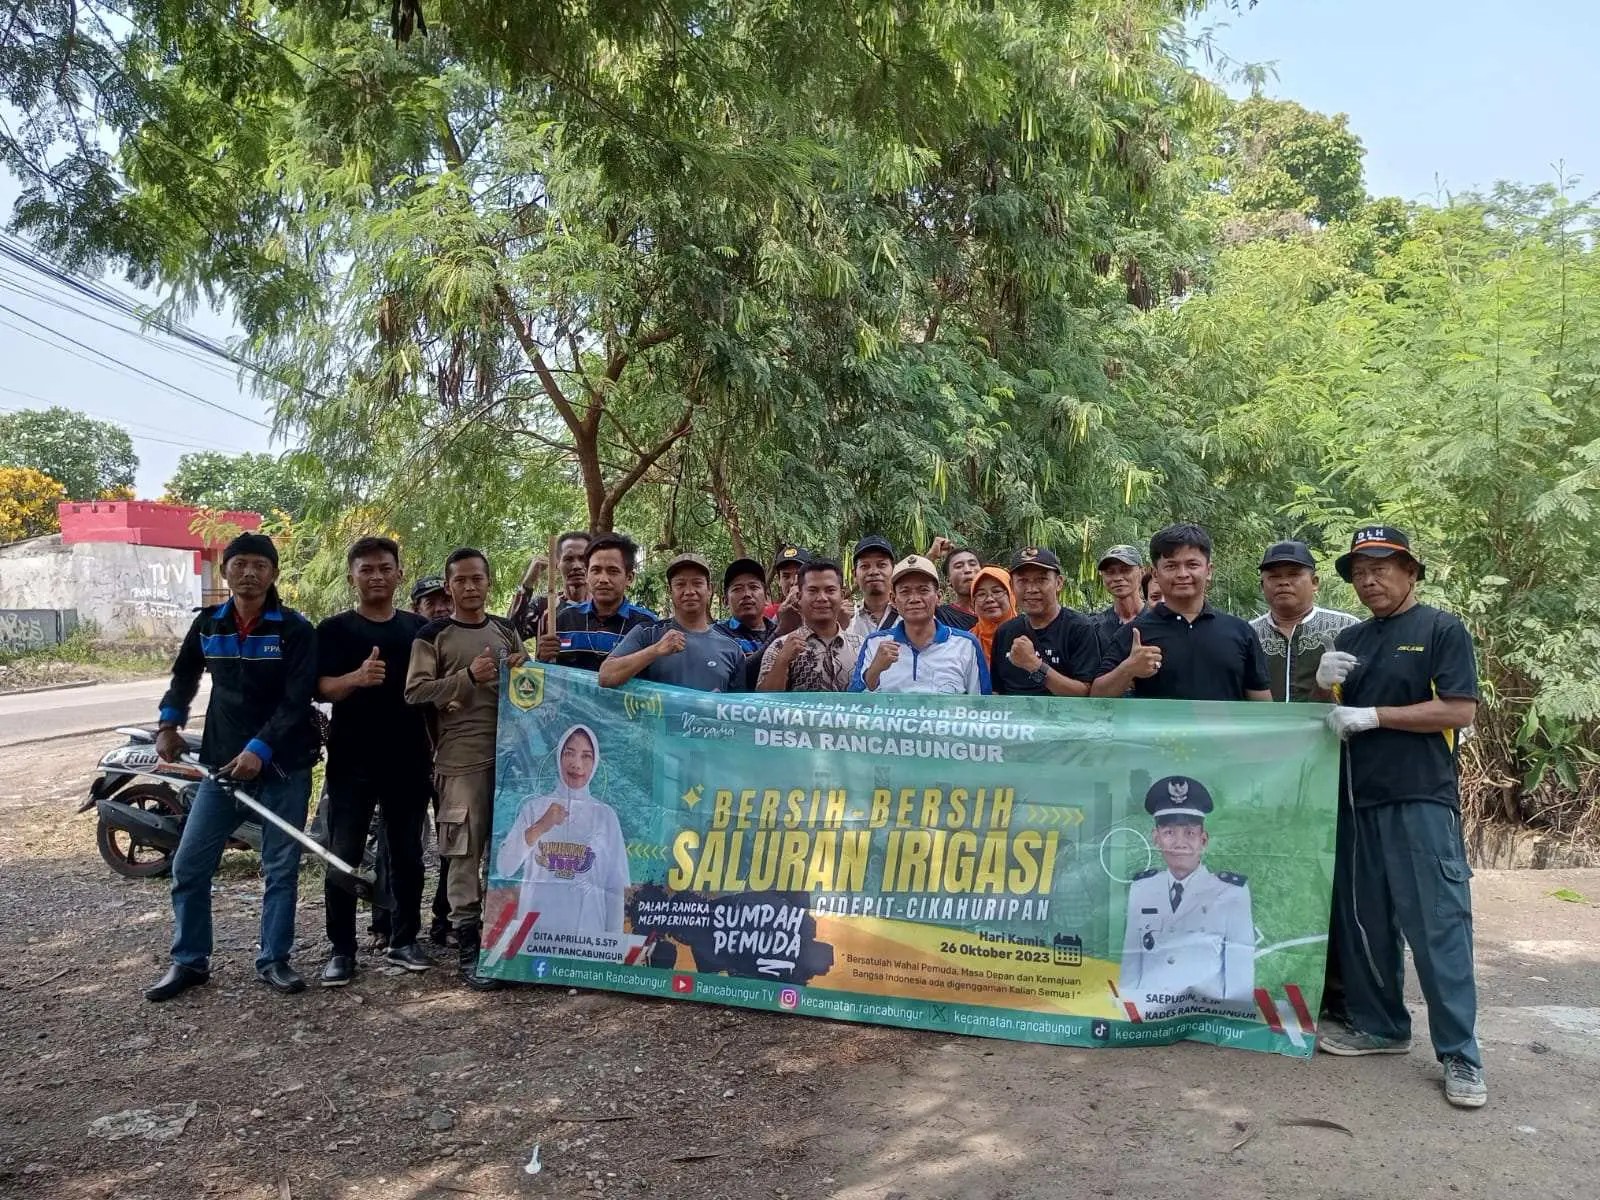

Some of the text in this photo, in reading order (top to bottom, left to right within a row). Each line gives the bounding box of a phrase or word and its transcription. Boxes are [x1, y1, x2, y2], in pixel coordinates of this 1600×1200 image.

[1357, 529, 1385, 540] DLH
[716, 703, 1036, 741] KECAMATAN RANCABUNGUR
[850, 704, 950, 718] Kabupaten
[954, 707, 1013, 722] Bogor
[681, 711, 737, 738] Bersama
[755, 728, 1005, 763] DESA RANCABUNGUR
[712, 787, 1015, 829] BERSIH-BERSIH
[668, 830, 871, 892] SALURAN
[881, 830, 1059, 895] IRIGASI
[638, 901, 710, 914] DALAM RANGKA
[638, 914, 710, 928] MEMPERINGATI
[713, 904, 805, 933] SUMPAH
[533, 932, 553, 941] DITA
[713, 930, 801, 958] PEMUDA
[979, 931, 1048, 948] Hari Kamis
[527, 944, 624, 961] CAMAT RANCABUNGUR
[940, 942, 1050, 963] 26 Oktober 2023
[552, 966, 604, 981] Kecamatan
[606, 971, 667, 990] Rancabungur
[852, 969, 884, 981] Bangsa
[929, 979, 945, 988] ada
[1009, 985, 1035, 996] Kalian
[1037, 988, 1071, 998] Semua
[961, 968, 984, 978] Masa
[986, 969, 1015, 982] Depan
[1016, 973, 1034, 983] dan
[1036, 974, 1082, 987] Kemajuan
[696, 981, 775, 1002] Rancabungur TV
[801, 994, 923, 1022] kecamatan.rancabungur
[1145, 1007, 1176, 1020] KADES
[954, 1010, 1083, 1037] kecamatan.rancabungur
[1115, 1020, 1244, 1040] kecamatan.rancabungur
